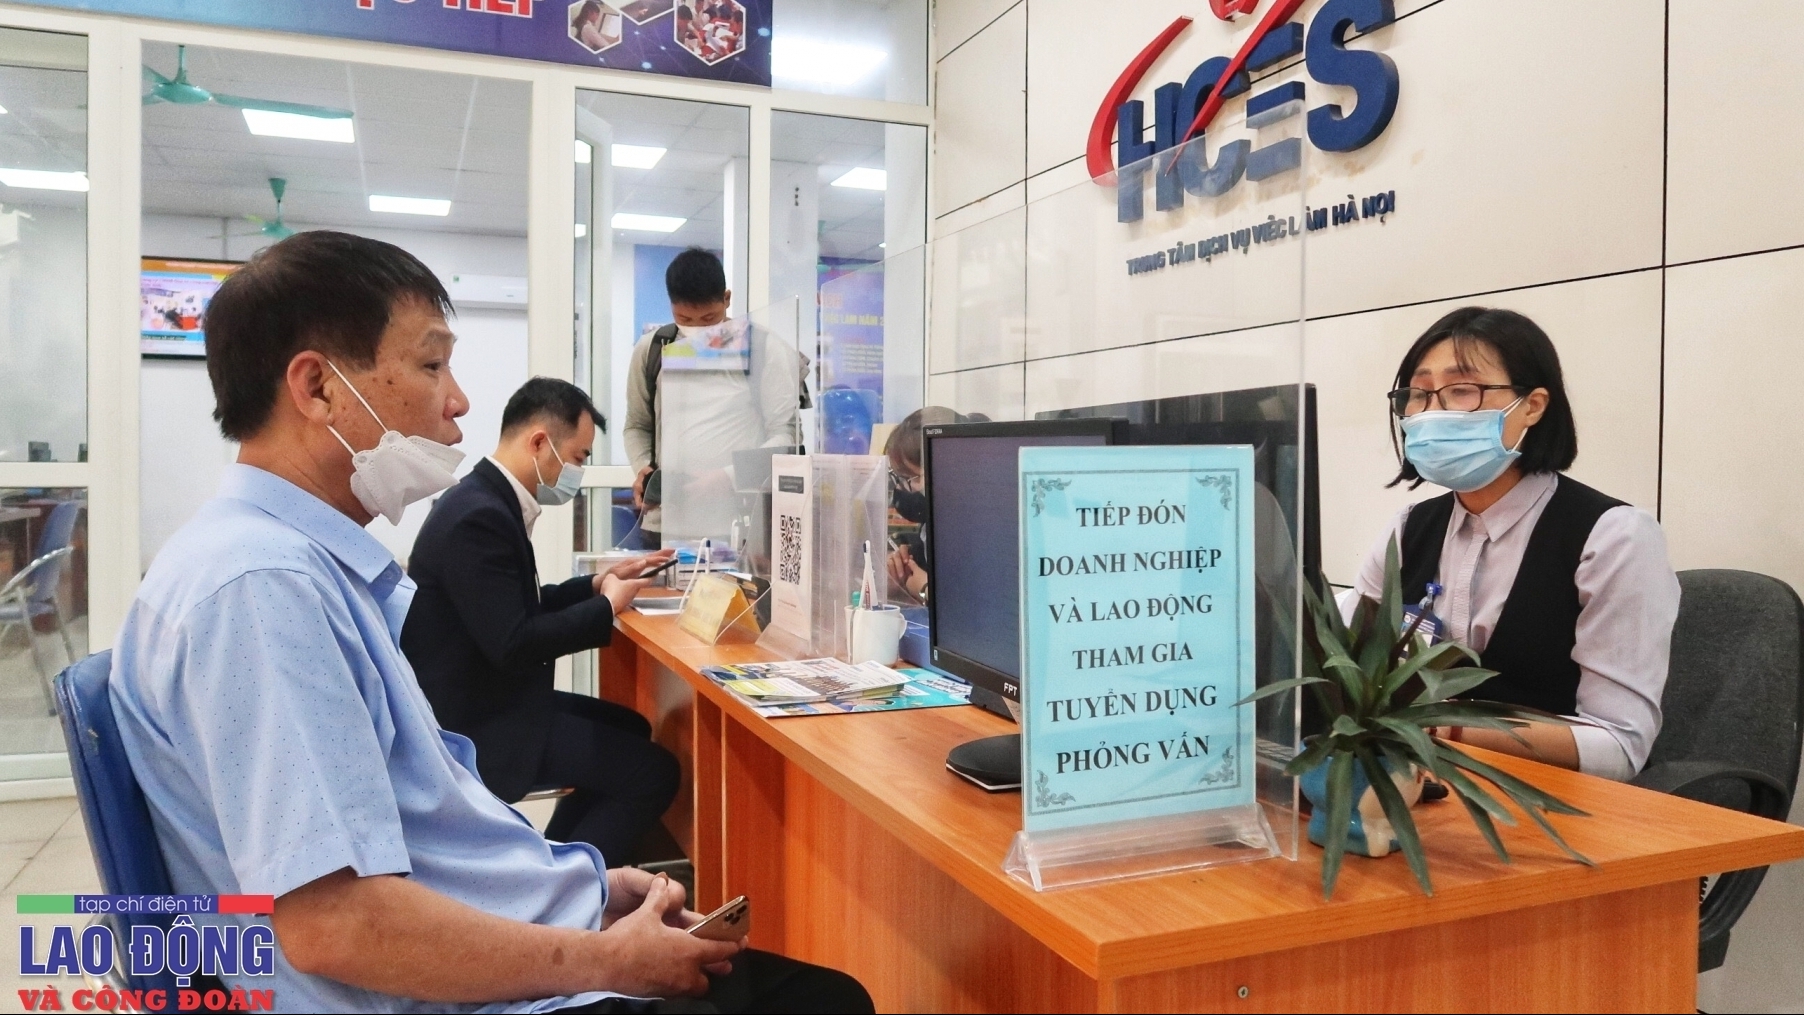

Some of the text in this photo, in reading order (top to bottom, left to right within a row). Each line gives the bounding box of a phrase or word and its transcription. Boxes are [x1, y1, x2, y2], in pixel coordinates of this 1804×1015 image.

[1117, 0, 1400, 223] HCES
[1126, 251, 1166, 276] TRUNG
[1167, 241, 1195, 266] TÂM
[1198, 234, 1228, 263] DỊCH
[1230, 227, 1251, 255] VỤ
[1331, 194, 1359, 226] HÀ
[1076, 499, 1187, 528] TIẾP ĐÓN
[1038, 546, 1222, 577] DOANH NGHIỆP
[1048, 593, 1213, 624] VÀ LAO ĐỘNG
[1072, 642, 1194, 670] THAM GIA
[1003, 681, 1018, 697] FPT
[1047, 685, 1217, 723] TUYỂN DỤNG
[1056, 731, 1210, 774] PHỎNG VẤN
